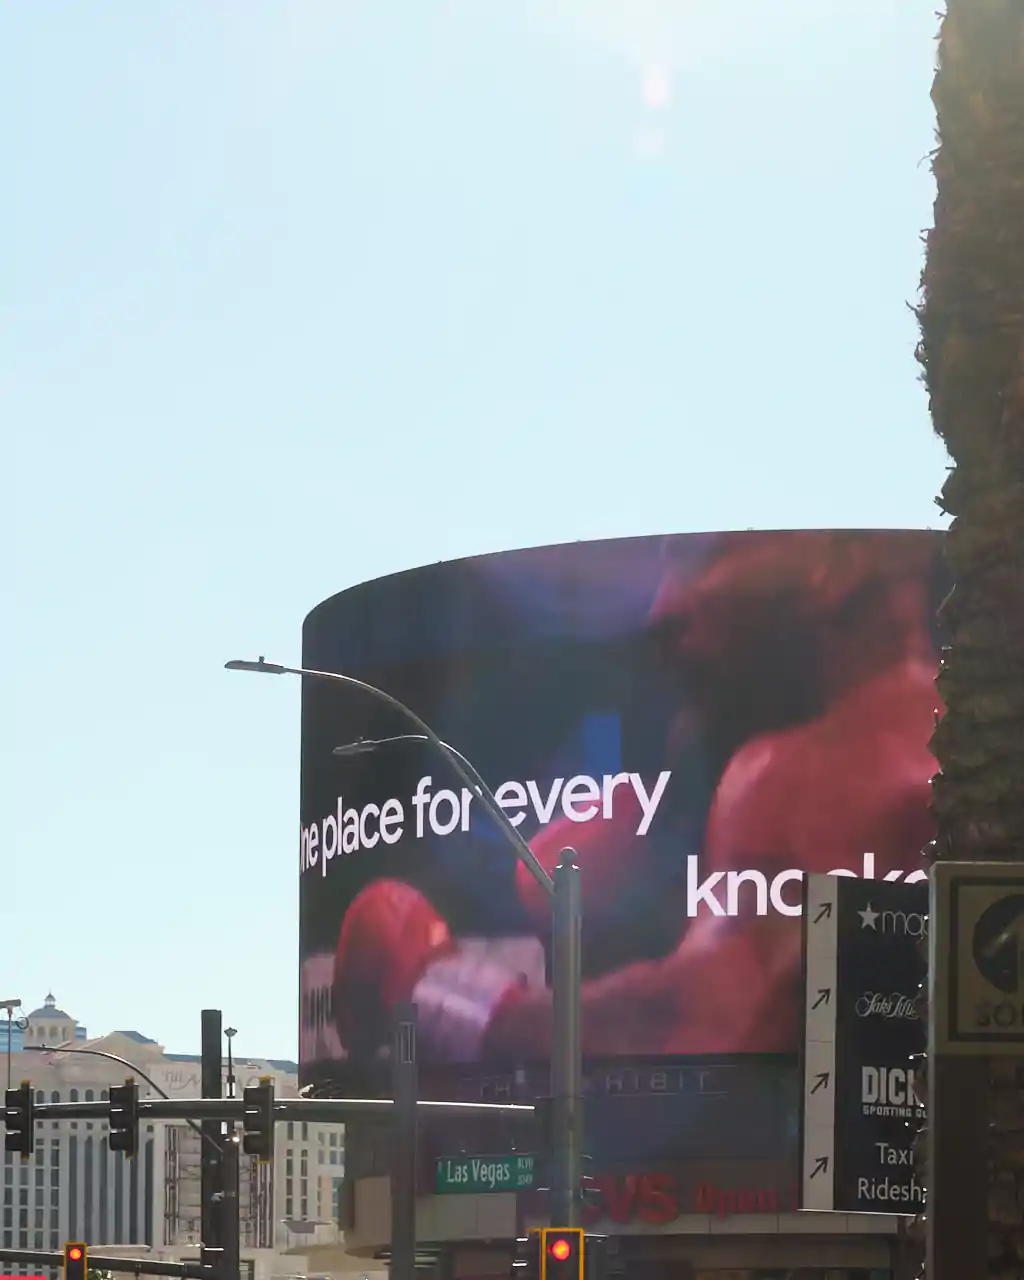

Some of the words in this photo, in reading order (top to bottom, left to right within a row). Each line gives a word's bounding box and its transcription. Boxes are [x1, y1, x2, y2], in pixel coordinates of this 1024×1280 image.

[322, 795, 403, 877] place
[411, 774, 473, 837] for
[494, 769, 671, 835] every
[875, 1141, 914, 1166] Taxi
[446, 1159, 469, 1183] Las
[471, 1159, 511, 1189] Vegas
[857, 1176, 925, 1203] Ridesh
